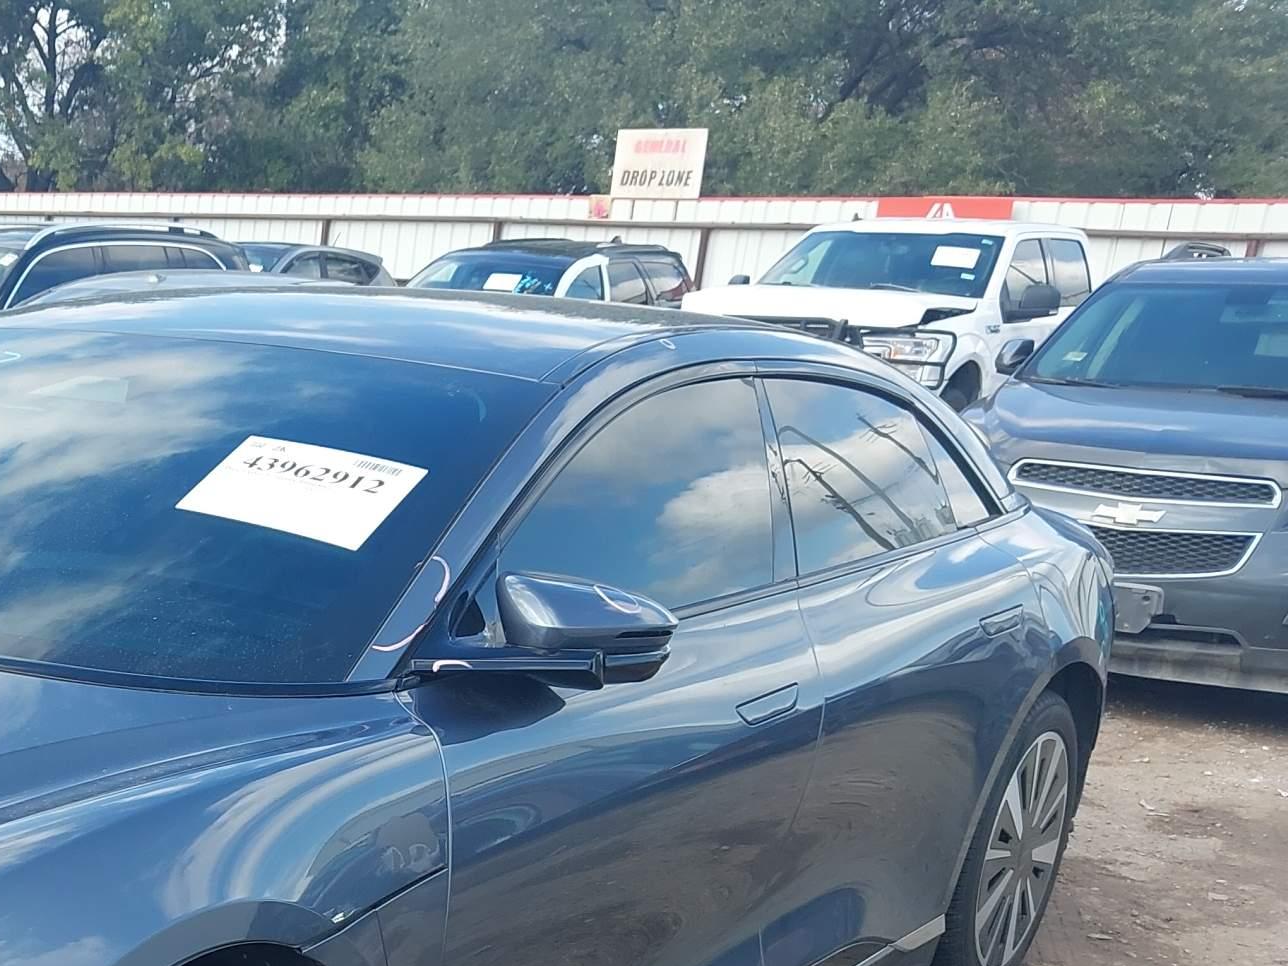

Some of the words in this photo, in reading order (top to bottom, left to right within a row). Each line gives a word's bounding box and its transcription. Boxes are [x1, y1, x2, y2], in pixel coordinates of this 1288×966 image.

[619, 169, 657, 187] DROP
[658, 169, 693, 187] ZONE
[242, 455, 385, 494] 43962912
